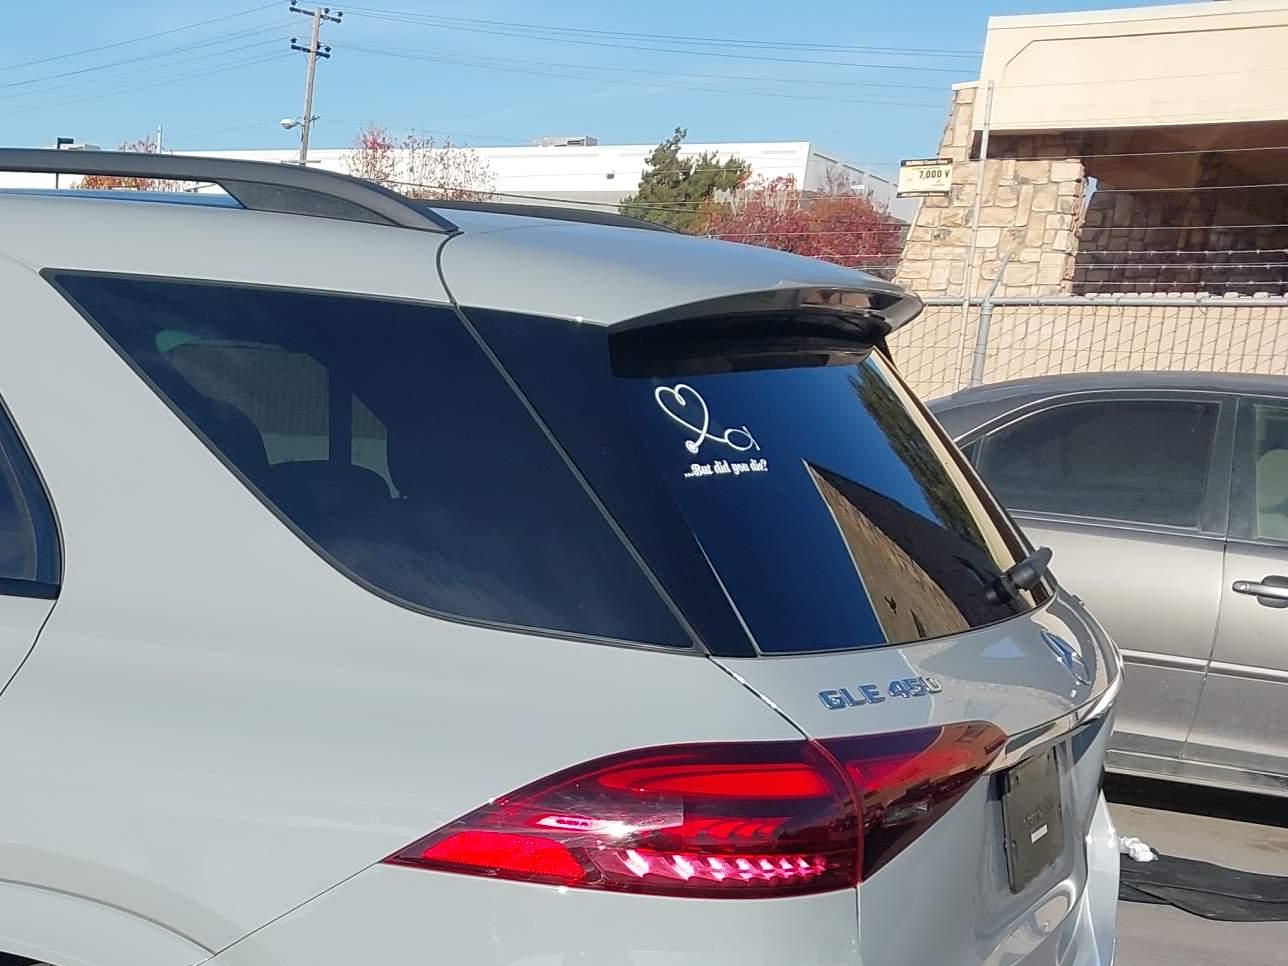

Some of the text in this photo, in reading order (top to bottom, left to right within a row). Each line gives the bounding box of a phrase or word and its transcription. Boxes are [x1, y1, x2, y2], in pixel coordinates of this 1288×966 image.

[919, 169, 951, 180] 7,000 V
[714, 459, 732, 474] did
[731, 462, 750, 475] you
[749, 458, 769, 472] die?
[818, 676, 943, 711] GLE 450
